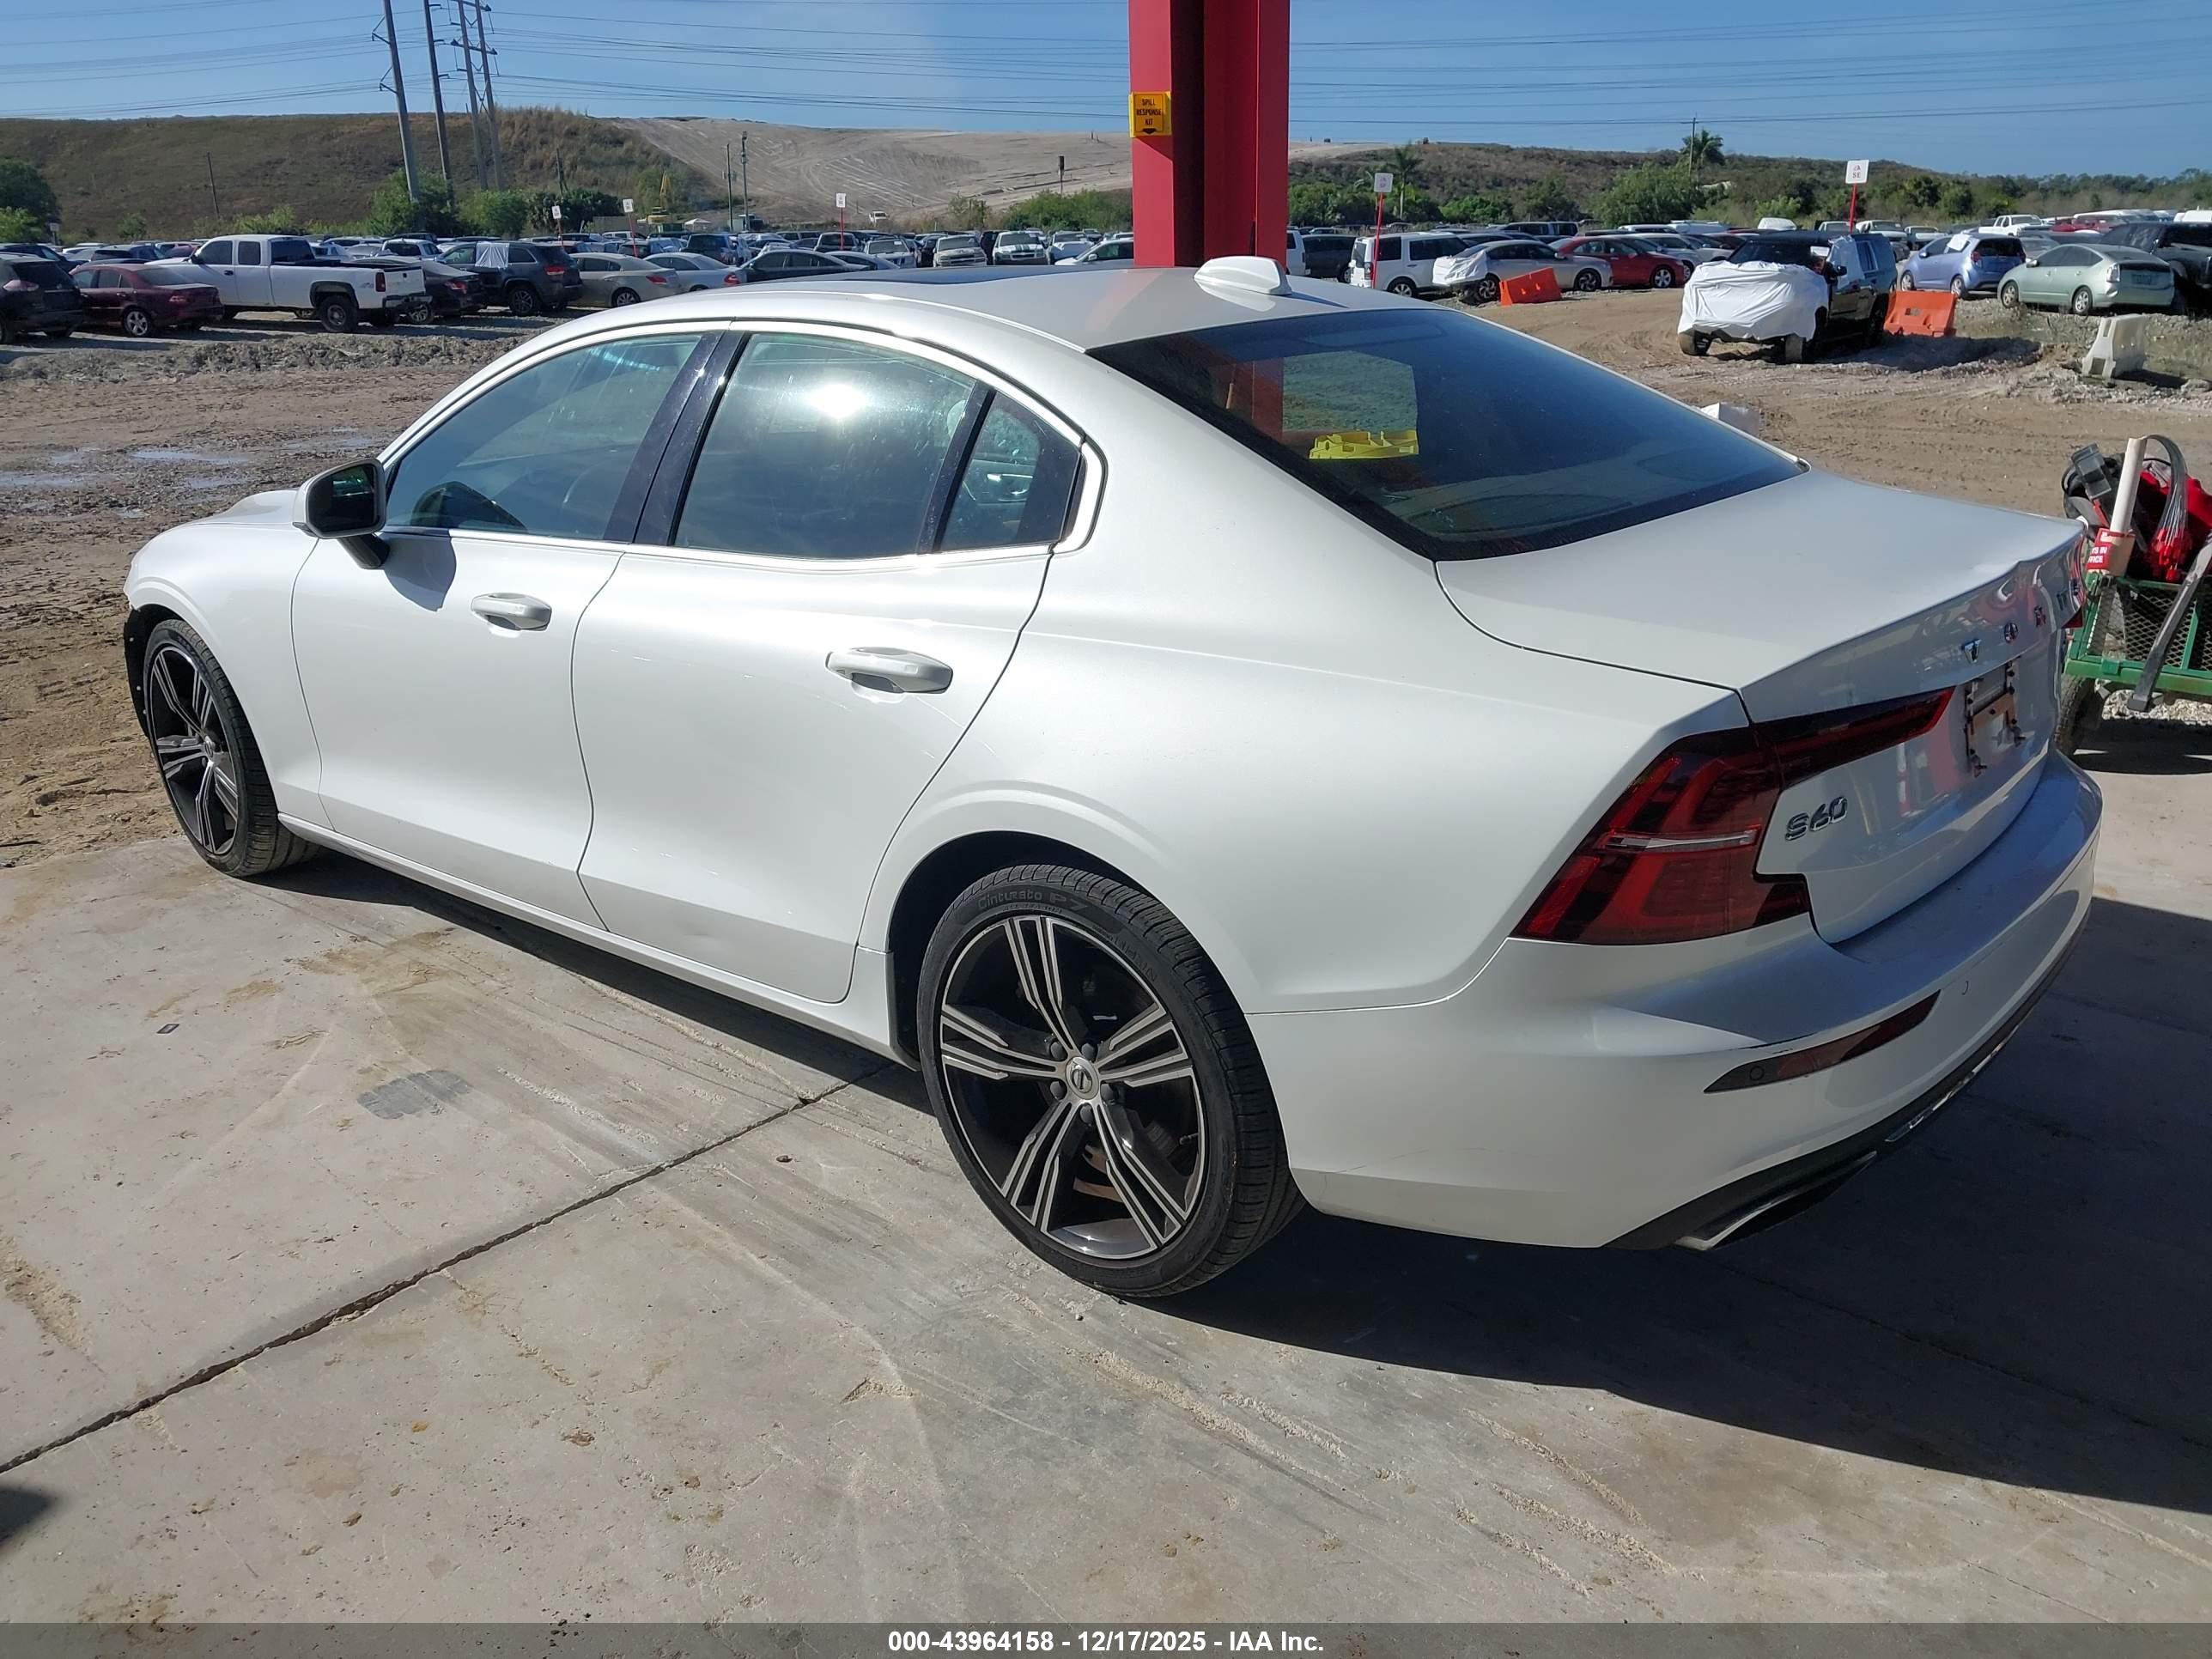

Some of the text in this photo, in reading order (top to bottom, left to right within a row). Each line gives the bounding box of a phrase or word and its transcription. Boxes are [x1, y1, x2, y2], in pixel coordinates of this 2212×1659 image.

[2100, 546, 2107, 555] IN
[1785, 795, 1848, 842] S60
[1048, 893, 1089, 913] P7
